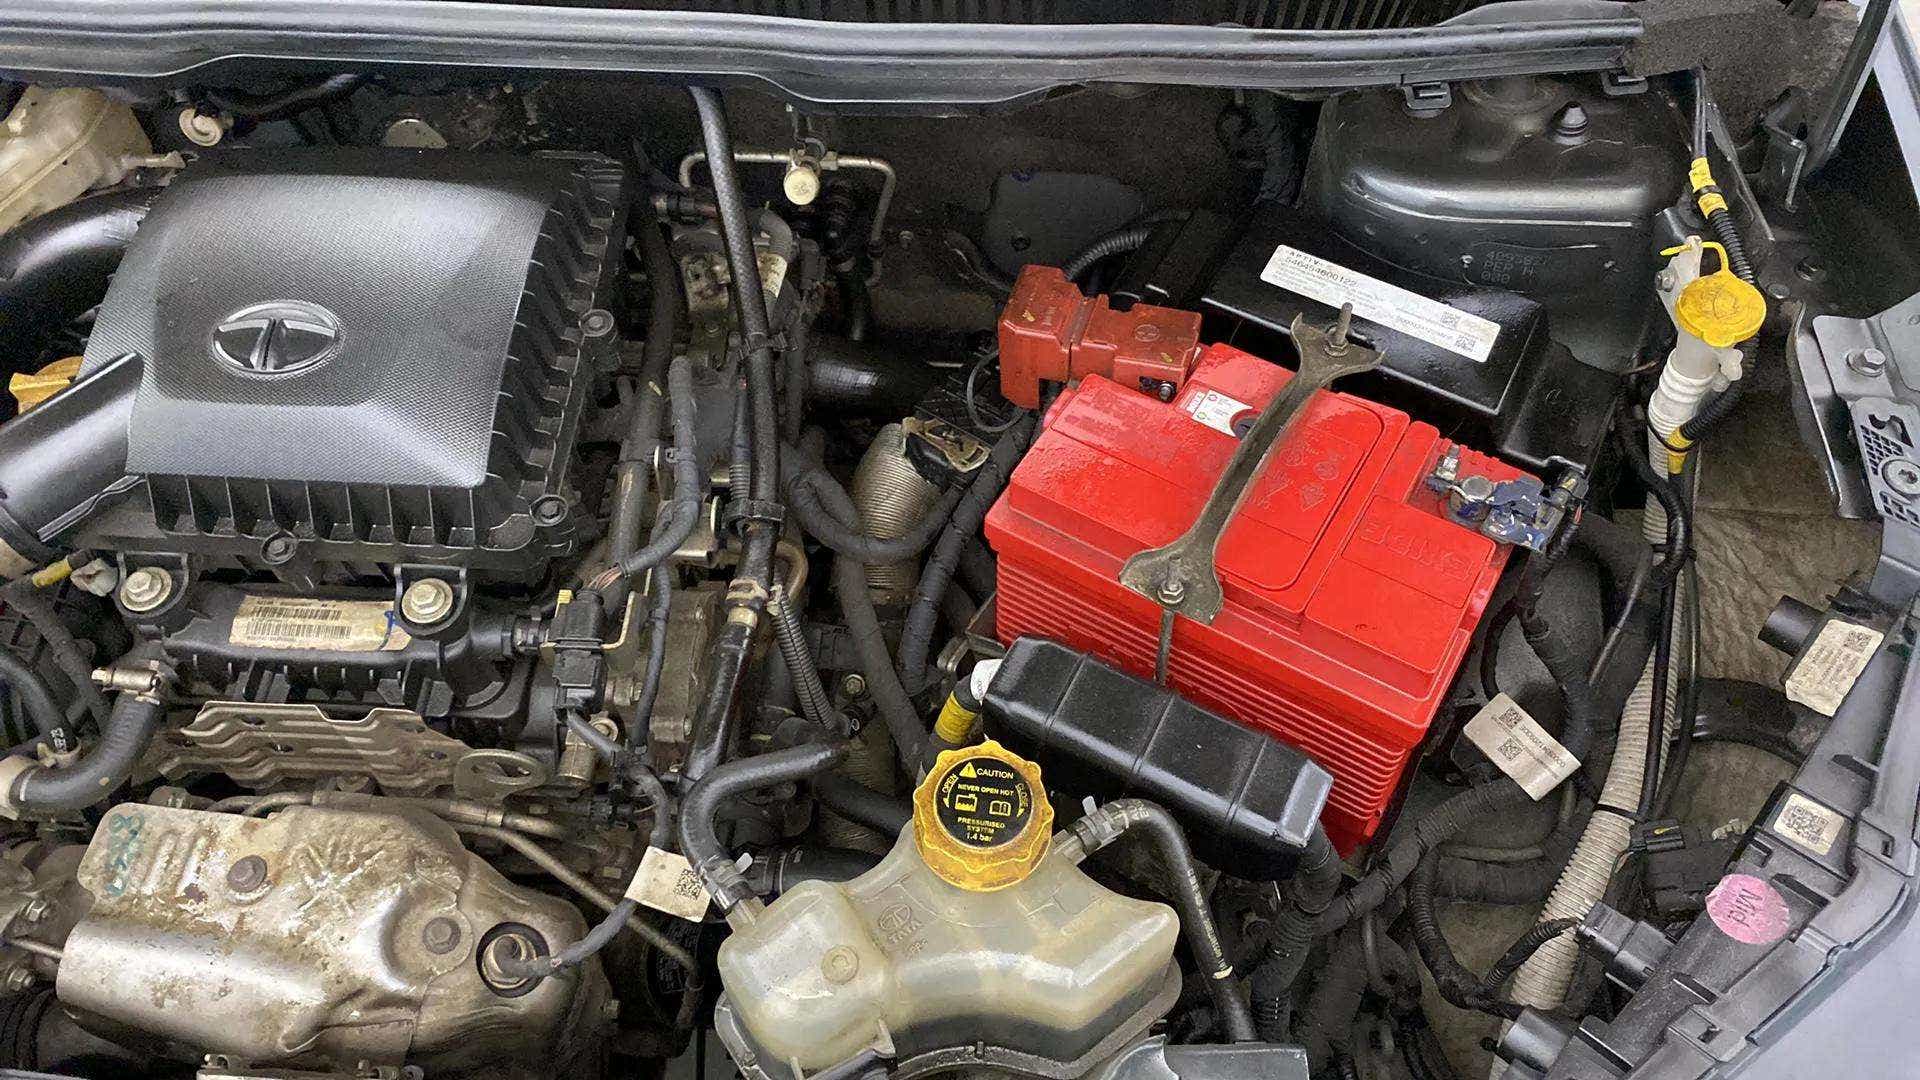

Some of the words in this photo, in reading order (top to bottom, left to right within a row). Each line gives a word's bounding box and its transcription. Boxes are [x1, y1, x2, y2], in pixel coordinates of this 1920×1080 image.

[976, 768, 1013, 779] CAUTION
[942, 773, 959, 793] OPEN
[1016, 783, 1028, 807] CLOSE
[958, 817, 1005, 828] PRESSURISED
[967, 825, 994, 833] SYSTEM
[979, 833, 992, 842] bar
